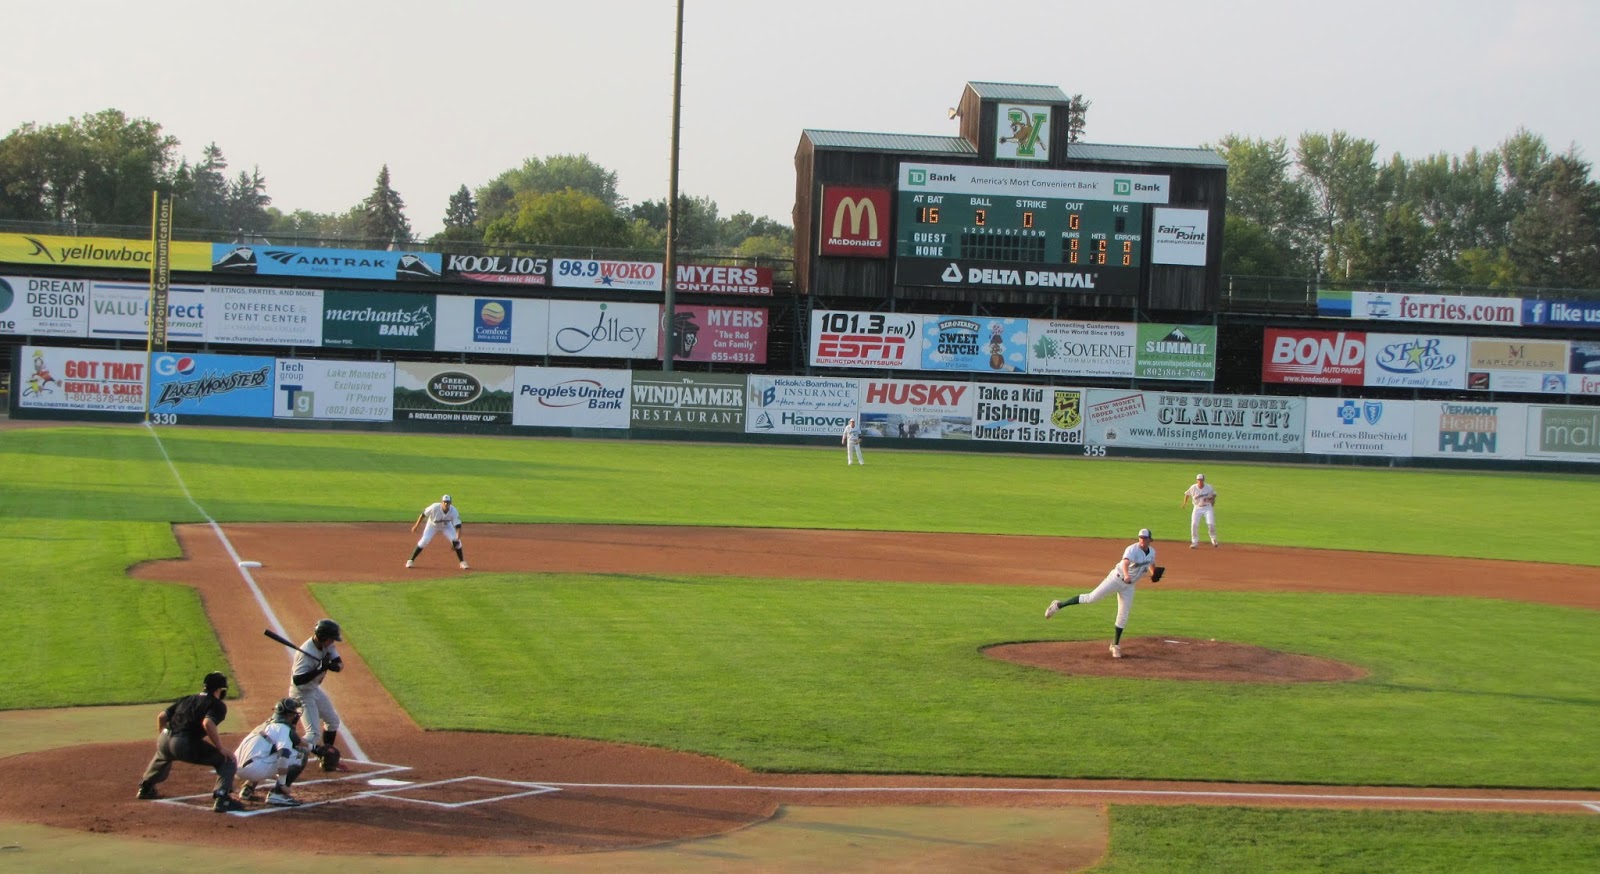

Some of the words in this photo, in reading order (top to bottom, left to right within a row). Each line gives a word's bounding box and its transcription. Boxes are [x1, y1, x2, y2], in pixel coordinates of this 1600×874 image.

[929, 173, 957, 182] Bank
[970, 176, 1008, 185] America's
[1009, 177, 1029, 187] Most
[1031, 179, 1076, 188] Convenient
[1077, 181, 1097, 190] Bank
[1134, 182, 1160, 192] Bank
[913, 195, 924, 203] AT
[927, 196, 944, 204] BAT
[970, 197, 992, 206] BALL
[1016, 200, 1047, 209] STRIKE
[1065, 202, 1084, 210] OUT
[922, 207, 939, 223] 16
[1112, 204, 1129, 213] H/E
[1023, 212, 1033, 228] 0
[1158, 225, 1180, 234] Fair
[1176, 231, 1205, 241] Point
[157, 198, 169, 290] Communications
[828, 238, 882, 247] McDonald's
[914, 232, 947, 244] GUEST
[60, 244, 152, 263] yellowboo
[915, 245, 943, 256] HOME
[297, 256, 385, 268] AMTRAK
[447, 255, 507, 273] KOOL
[509, 257, 549, 275] 105
[559, 260, 599, 277] 98.9
[600, 263, 656, 280] WOKO
[676, 265, 758, 285] MYERS
[498, 275, 523, 283] Classic
[968, 268, 1022, 285] DELTA
[1025, 271, 1095, 289] DENTAL
[28, 279, 84, 293] DREAM
[675, 283, 770, 294] ONTAINERS
[27, 292, 85, 306] DESIGN
[32, 306, 79, 319] BUILD
[94, 300, 204, 318] VALU-rect
[224, 302, 296, 312] CONFERENCE
[1399, 296, 1515, 323] ferries.com
[1550, 303, 1582, 321] like
[155, 293, 167, 345] FairPoint
[224, 313, 259, 322] EVENT
[264, 314, 307, 323] CENTER
[326, 307, 412, 323] merchants
[707, 309, 764, 328] MYERS
[379, 324, 420, 336] BANK
[475, 326, 508, 335] Comfort
[821, 313, 886, 334] 101.3
[887, 326, 904, 335] FM
[735, 331, 749, 339] Red
[938, 333, 979, 344] SWEET
[817, 334, 906, 359] ESPN
[937, 344, 979, 355] CATCH!
[1063, 342, 1134, 358] SOVERNET
[1145, 340, 1207, 355] SUMMIT
[1271, 332, 1365, 370] BOND
[711, 352, 755, 362] 655-4312
[1477, 359, 1555, 368] MAPLEFIELDS
[65, 360, 99, 379] GOT
[102, 362, 144, 380] THAT
[280, 361, 304, 372] Tech
[1322, 366, 1340, 374] AUTO
[1341, 367, 1362, 375] PARTS
[280, 372, 304, 381] group
[327, 369, 347, 378] Lake
[349, 370, 387, 379] Monsters
[1283, 375, 1342, 384] www.bondauto.com
[156, 380, 198, 407] LAKE
[195, 367, 270, 400] MONSTERS
[334, 381, 372, 391] Exclusive
[774, 379, 798, 387] Hickok
[806, 380, 844, 389] Boardman,
[845, 381, 858, 389] Inc.
[1387, 377, 1398, 385] for
[1400, 377, 1430, 386] Family
[1431, 378, 1453, 387] Fun!
[64, 382, 101, 394] RENTAL
[112, 383, 143, 396] SALES
[520, 384, 577, 399] People's
[578, 386, 625, 399] United
[784, 388, 851, 398] INSURANCE
[866, 383, 968, 406] HUSKY
[978, 386, 1009, 401] Take
[1011, 389, 1019, 401] a
[1022, 388, 1043, 402] Kid
[346, 394, 355, 402] IT
[357, 394, 387, 403] Partner
[632, 384, 743, 408] WINDJAMMER
[1159, 395, 1188, 407] IT'S
[1191, 396, 1233, 408] YOUR
[1237, 398, 1292, 410] MONEY.
[325, 405, 348, 416] (802)
[588, 399, 622, 410] Bank
[815, 401, 826, 409] you
[1091, 410, 1114, 419] ADDED
[1115, 403, 1142, 413] YEARLY
[1094, 404, 1110, 412] NEW
[1112, 398, 1136, 407] MONEY
[1441, 403, 1498, 415] VERMONT
[153, 413, 177, 425] 330
[632, 409, 743, 424] RESTAURANT
[781, 412, 852, 426] Hanover
[977, 402, 1044, 425] Fishing.
[1157, 407, 1245, 427] CLAIM
[1251, 410, 1291, 429] IT!
[1441, 415, 1495, 432] Health
[975, 425, 1014, 440] Under
[1017, 427, 1031, 441] 15
[1034, 427, 1046, 441] is
[1049, 429, 1081, 443] Free!
[1129, 427, 1300, 443] www.MissingMoney.Vermont.gov
[1311, 429, 1357, 439] BlueCross
[1358, 431, 1407, 441] BlueShield
[1333, 441, 1343, 449] of
[1345, 441, 1384, 450] Vermont
[1439, 431, 1497, 453] PLAN
[1083, 445, 1106, 457] 355
